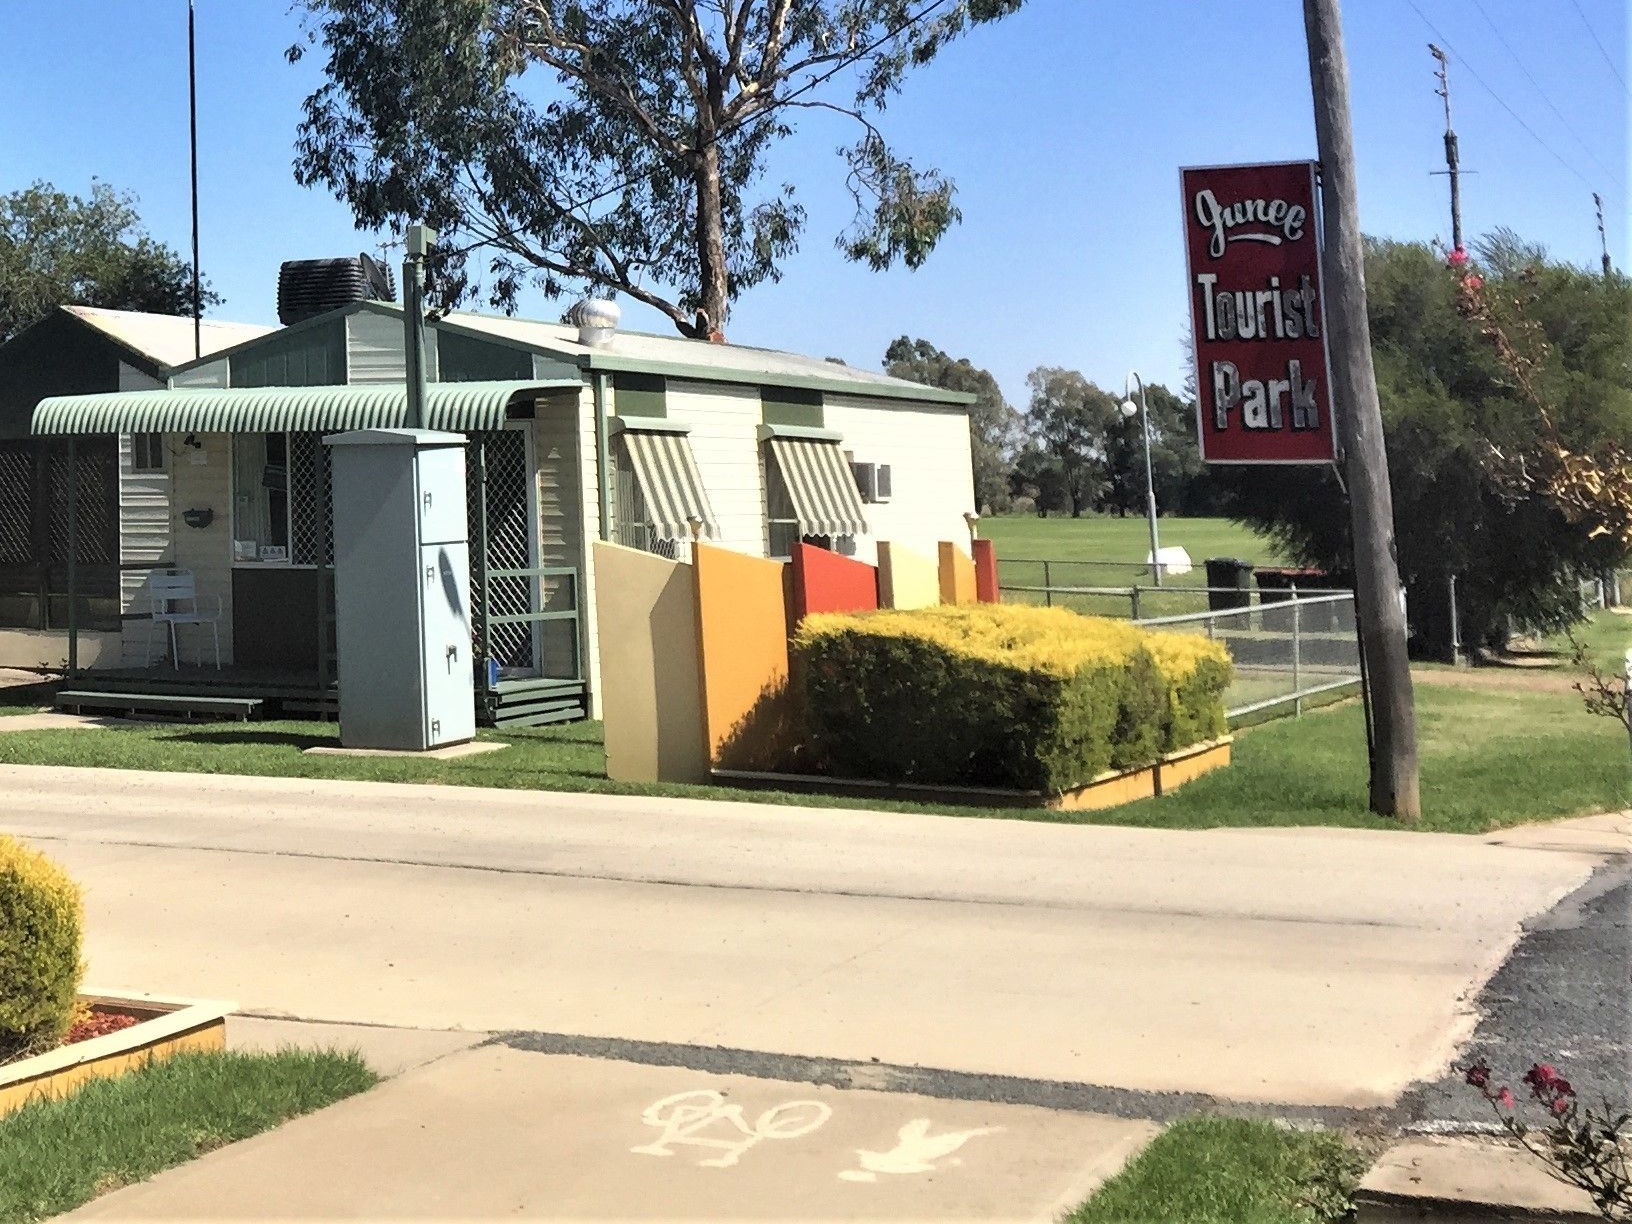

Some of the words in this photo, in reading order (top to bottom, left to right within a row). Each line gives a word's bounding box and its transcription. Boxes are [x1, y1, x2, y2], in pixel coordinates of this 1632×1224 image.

[1195, 189, 1306, 258] Junee
[1197, 273, 1320, 340] Tourist
[1213, 359, 1319, 429] Park
